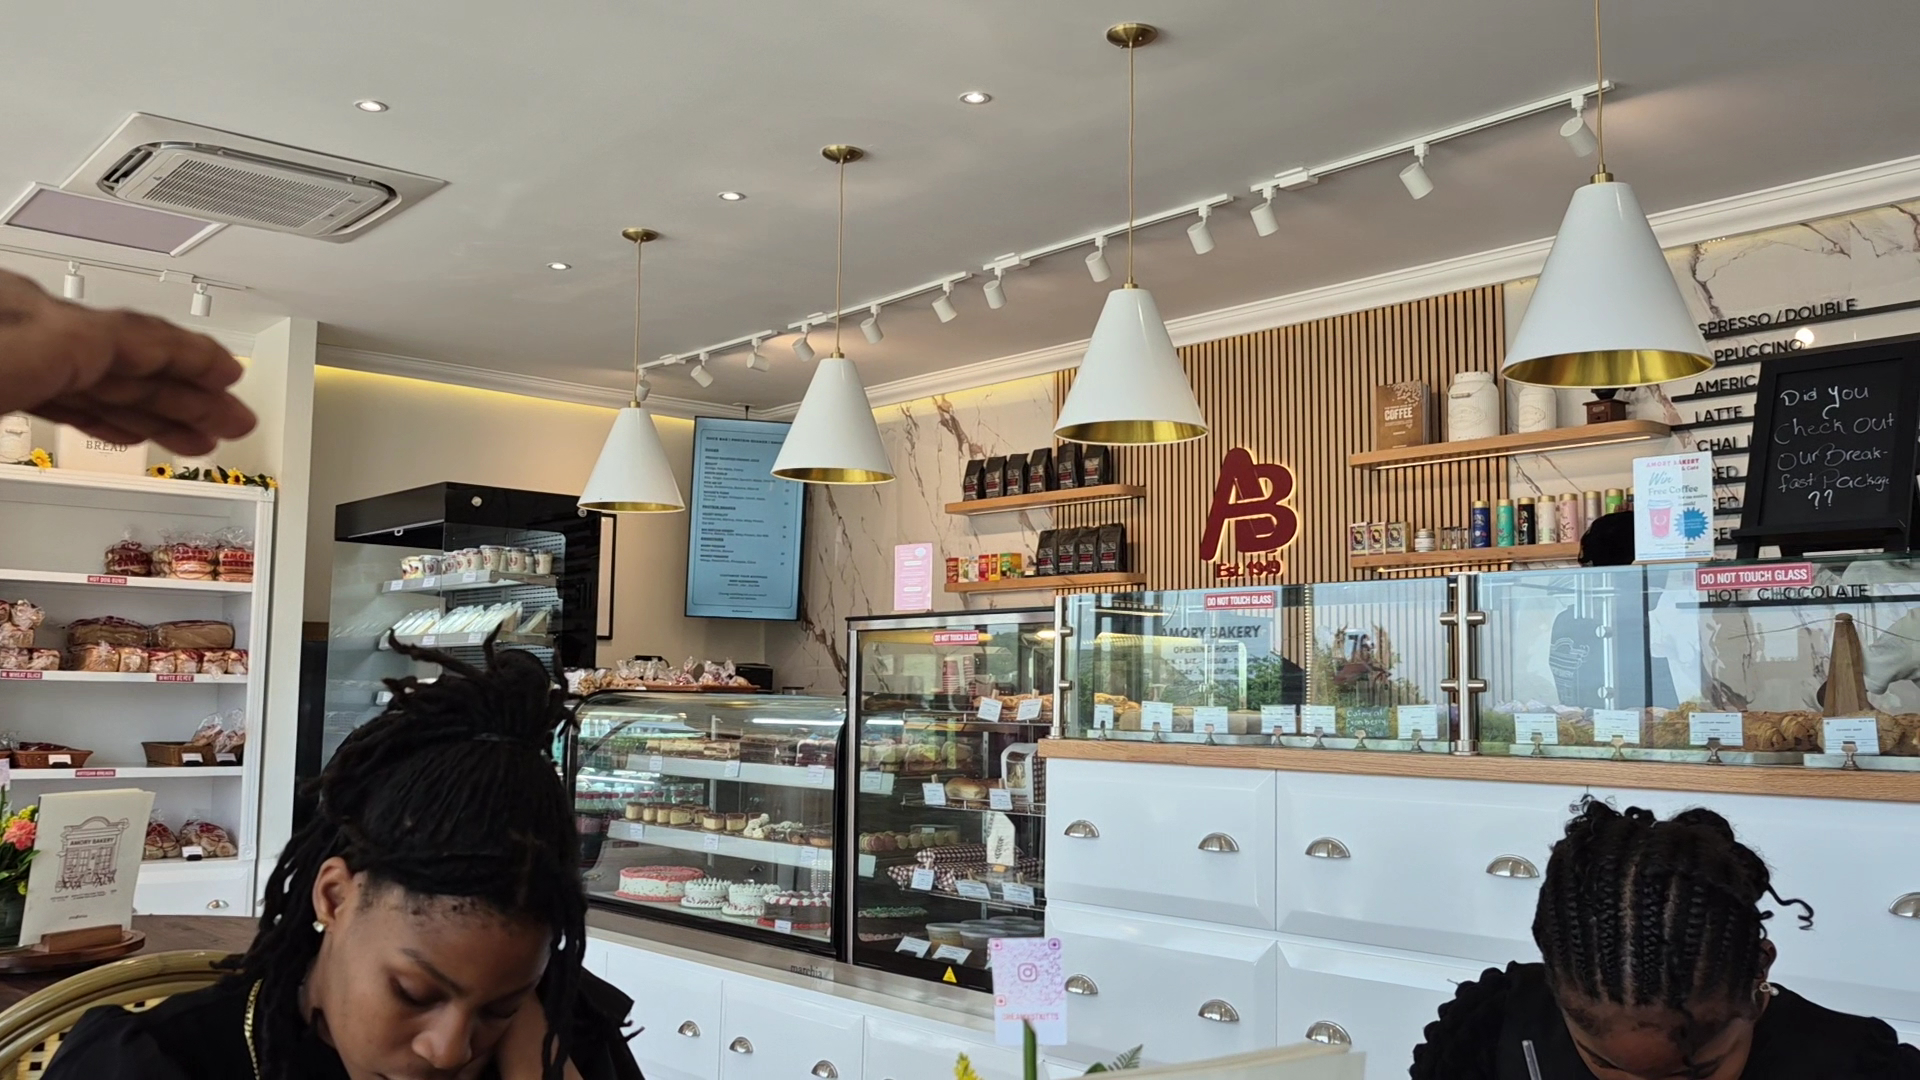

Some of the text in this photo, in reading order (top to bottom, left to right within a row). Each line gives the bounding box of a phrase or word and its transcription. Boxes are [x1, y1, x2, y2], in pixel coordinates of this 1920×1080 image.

[1698, 312, 1771, 334] SPRESSO
[1785, 298, 1858, 321] DOUBLE
[1714, 339, 1804, 361] PPUCCINO
[1694, 375, 1757, 396] AMERIC
[1780, 387, 1818, 406] Did
[1384, 407, 1413, 421] COFFEE
[1695, 406, 1743, 423] LATTE
[86, 440, 128, 452] BREAD
[1648, 471, 1673, 486] Win
[1648, 484, 1699, 496] Free Coffee
[223, 552, 254, 560] AMOR
[1701, 569, 1808, 585] DO NOT TOUCH GLASS
[1207, 594, 1272, 606] DO NOT TOUCH GLASS
[1708, 583, 1869, 602] HOT CHOCOLATE
[1161, 625, 1261, 638] AMORY BAKERY
[1213, 645, 1240, 653] HOUR
